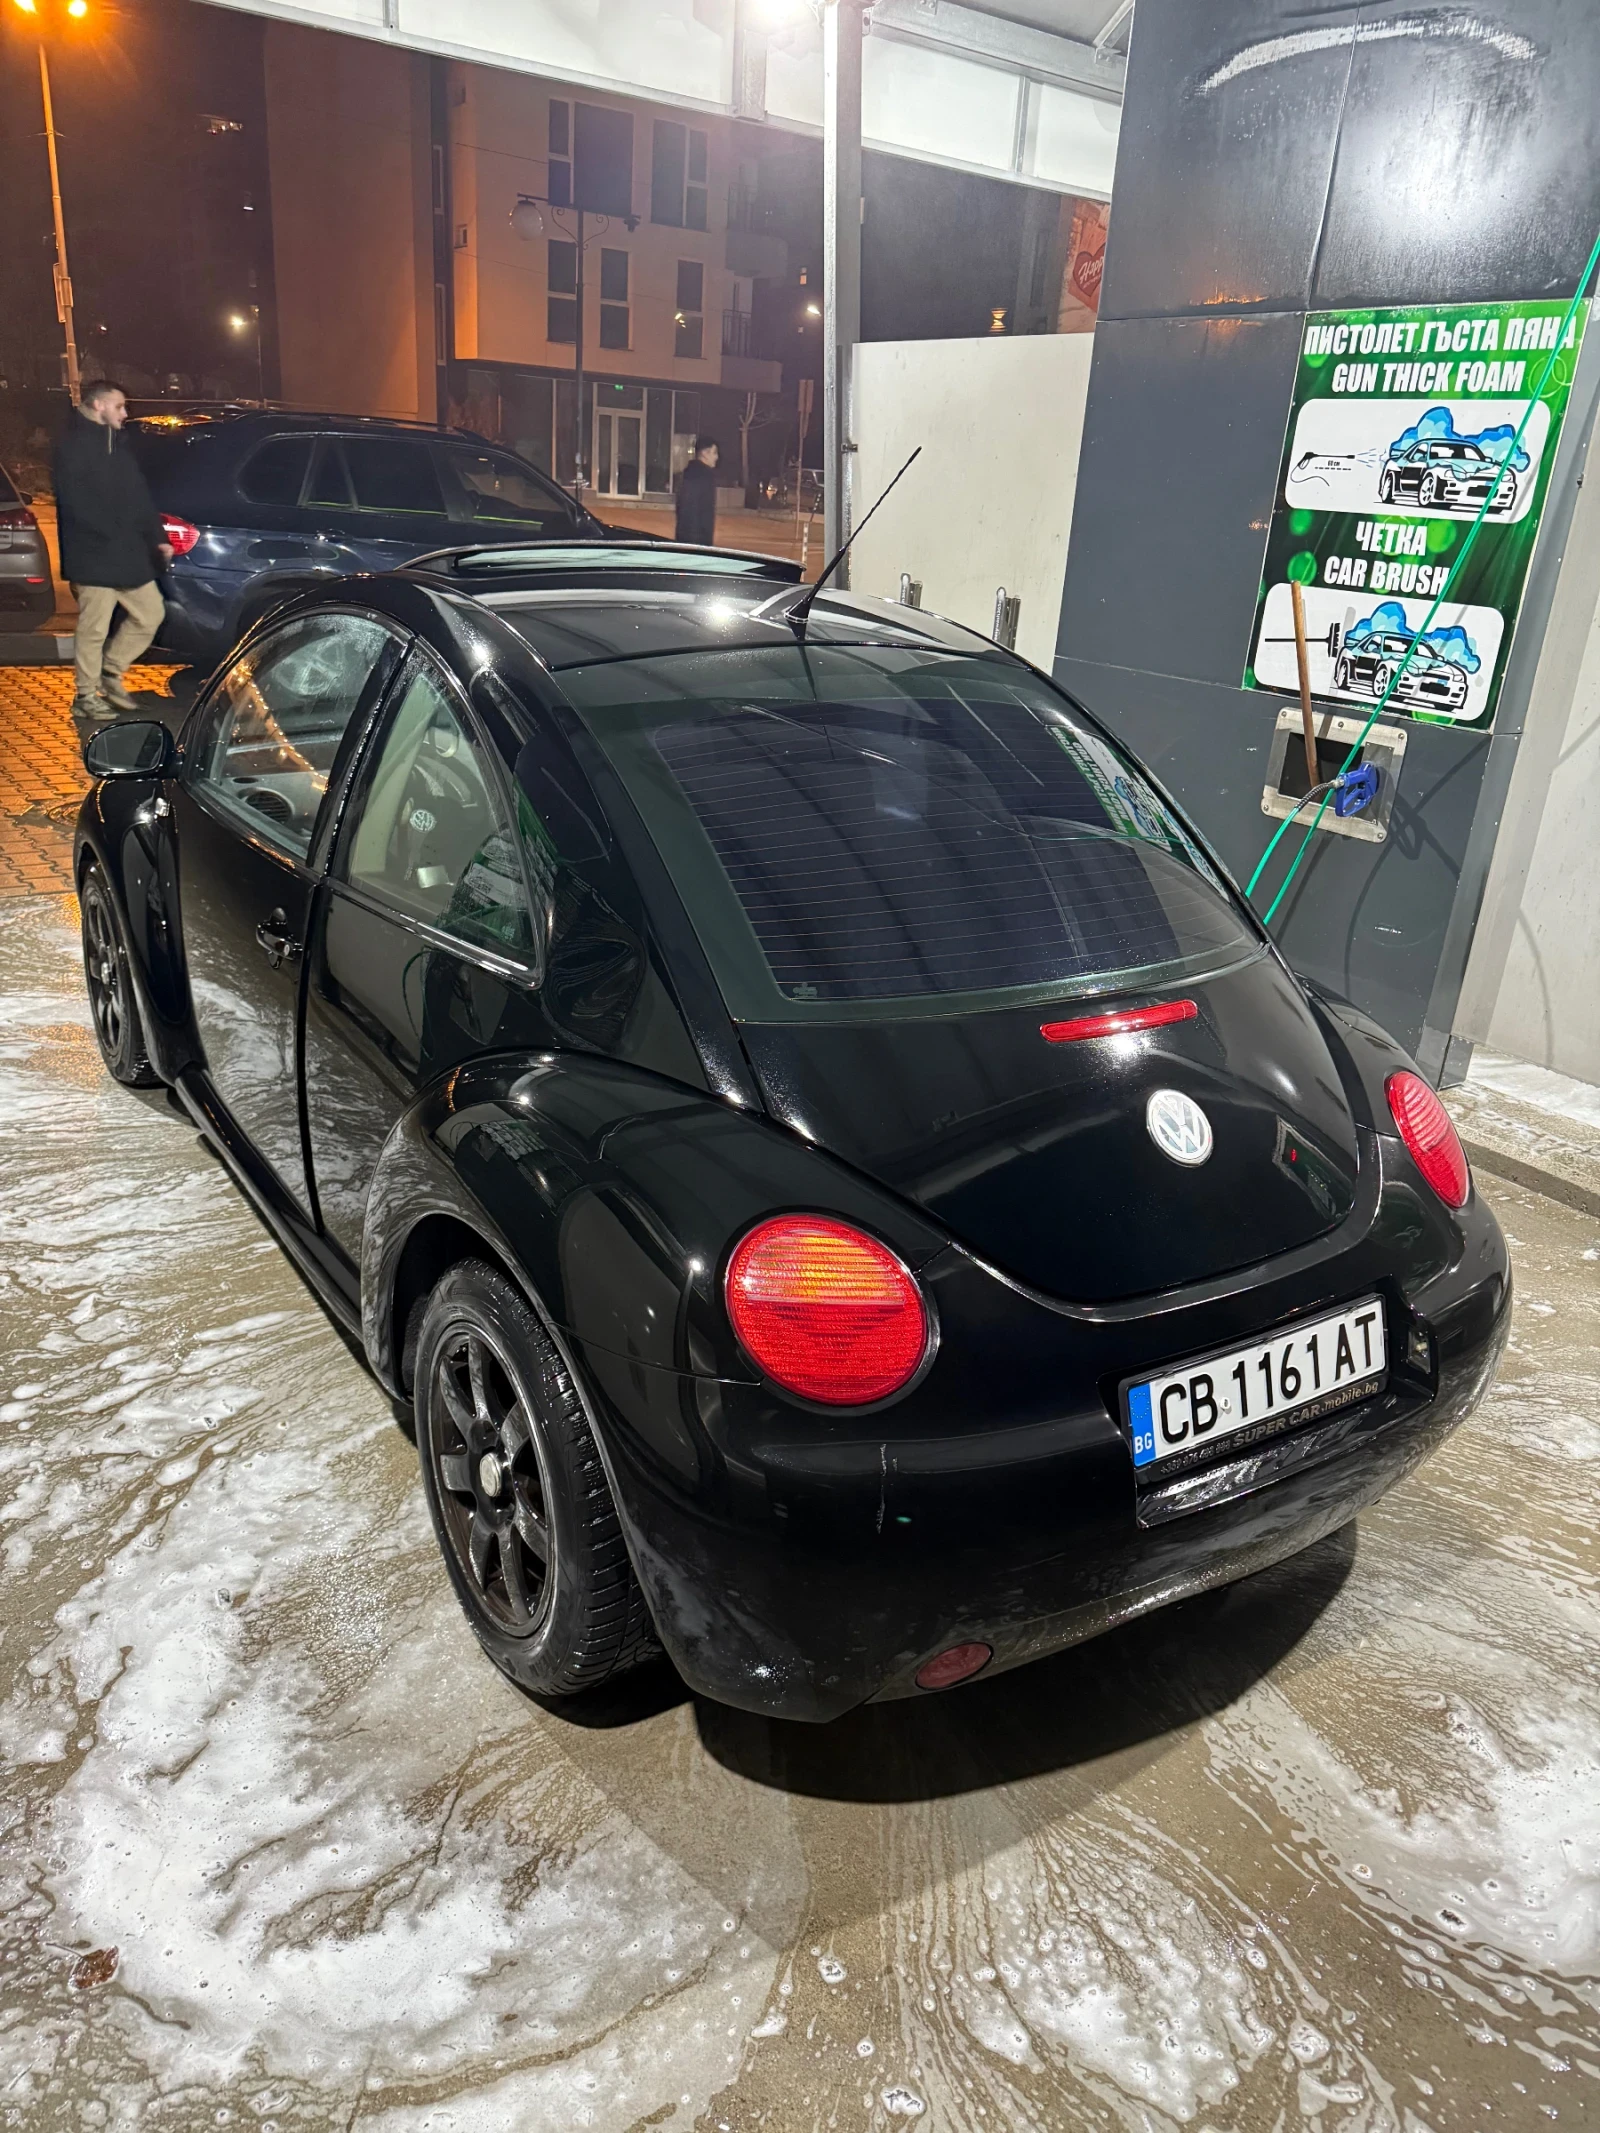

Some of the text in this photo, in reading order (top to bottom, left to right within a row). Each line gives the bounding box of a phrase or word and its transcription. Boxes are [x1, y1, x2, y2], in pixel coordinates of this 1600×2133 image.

[1304, 317, 1576, 354] ПИСТОЛЕТ ГЪСТА ПЯНА
[1331, 360, 1527, 392] GUN THICK FOAM
[1355, 521, 1428, 556] ЧЕТКА
[1324, 556, 1451, 596] CAR BRUSH
[1149, 1091, 1210, 1164] VW
[1159, 1311, 1377, 1444] CB 1161 AT
[1134, 1430, 1154, 1454] BG
[1232, 1417, 1286, 1448] SUPER
